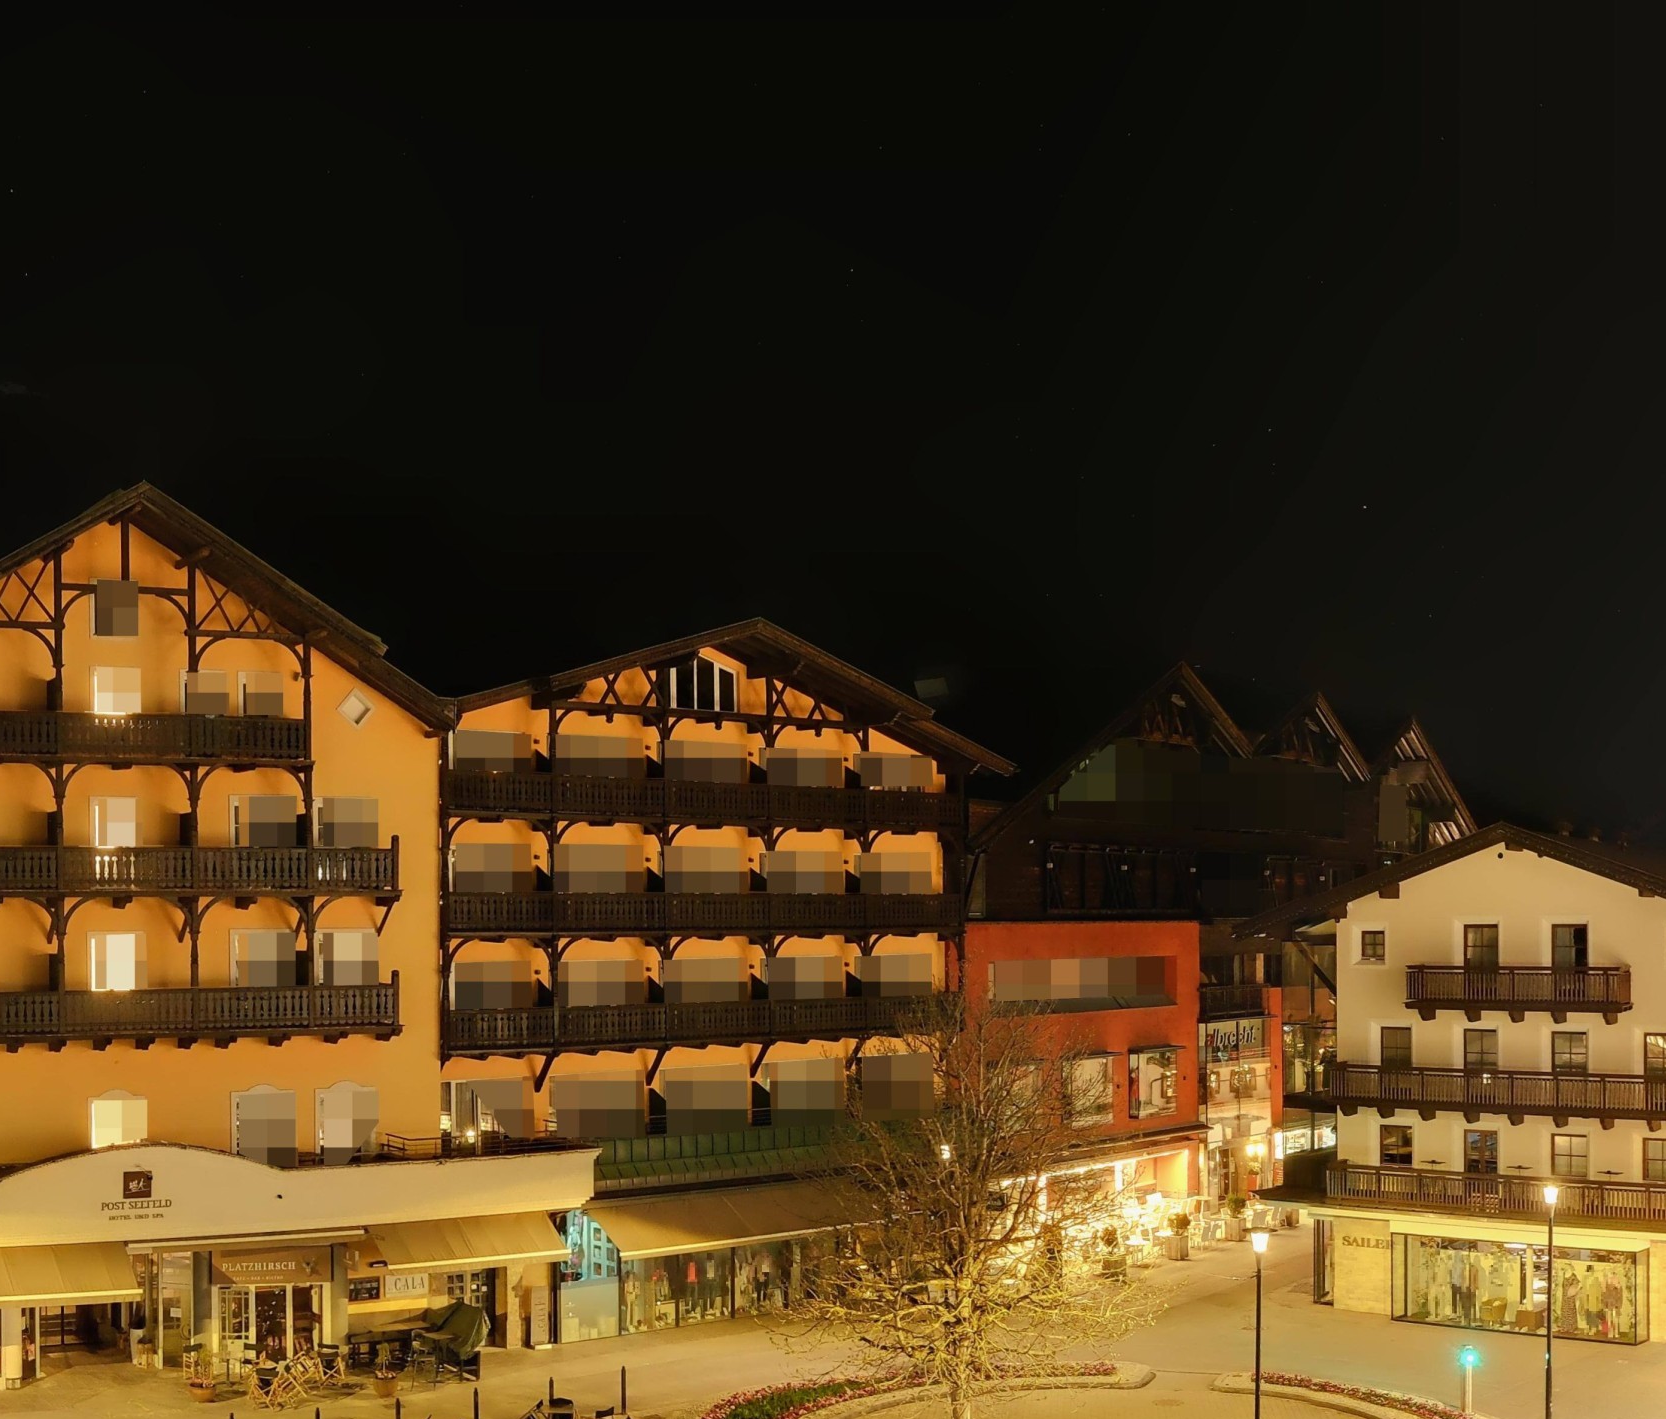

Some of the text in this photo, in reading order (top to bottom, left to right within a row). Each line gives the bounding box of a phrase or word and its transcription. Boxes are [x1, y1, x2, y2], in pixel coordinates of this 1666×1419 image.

[101, 1199, 172, 1211] POST SEEFELD
[222, 1261, 296, 1272] PLATZHIRSCH
